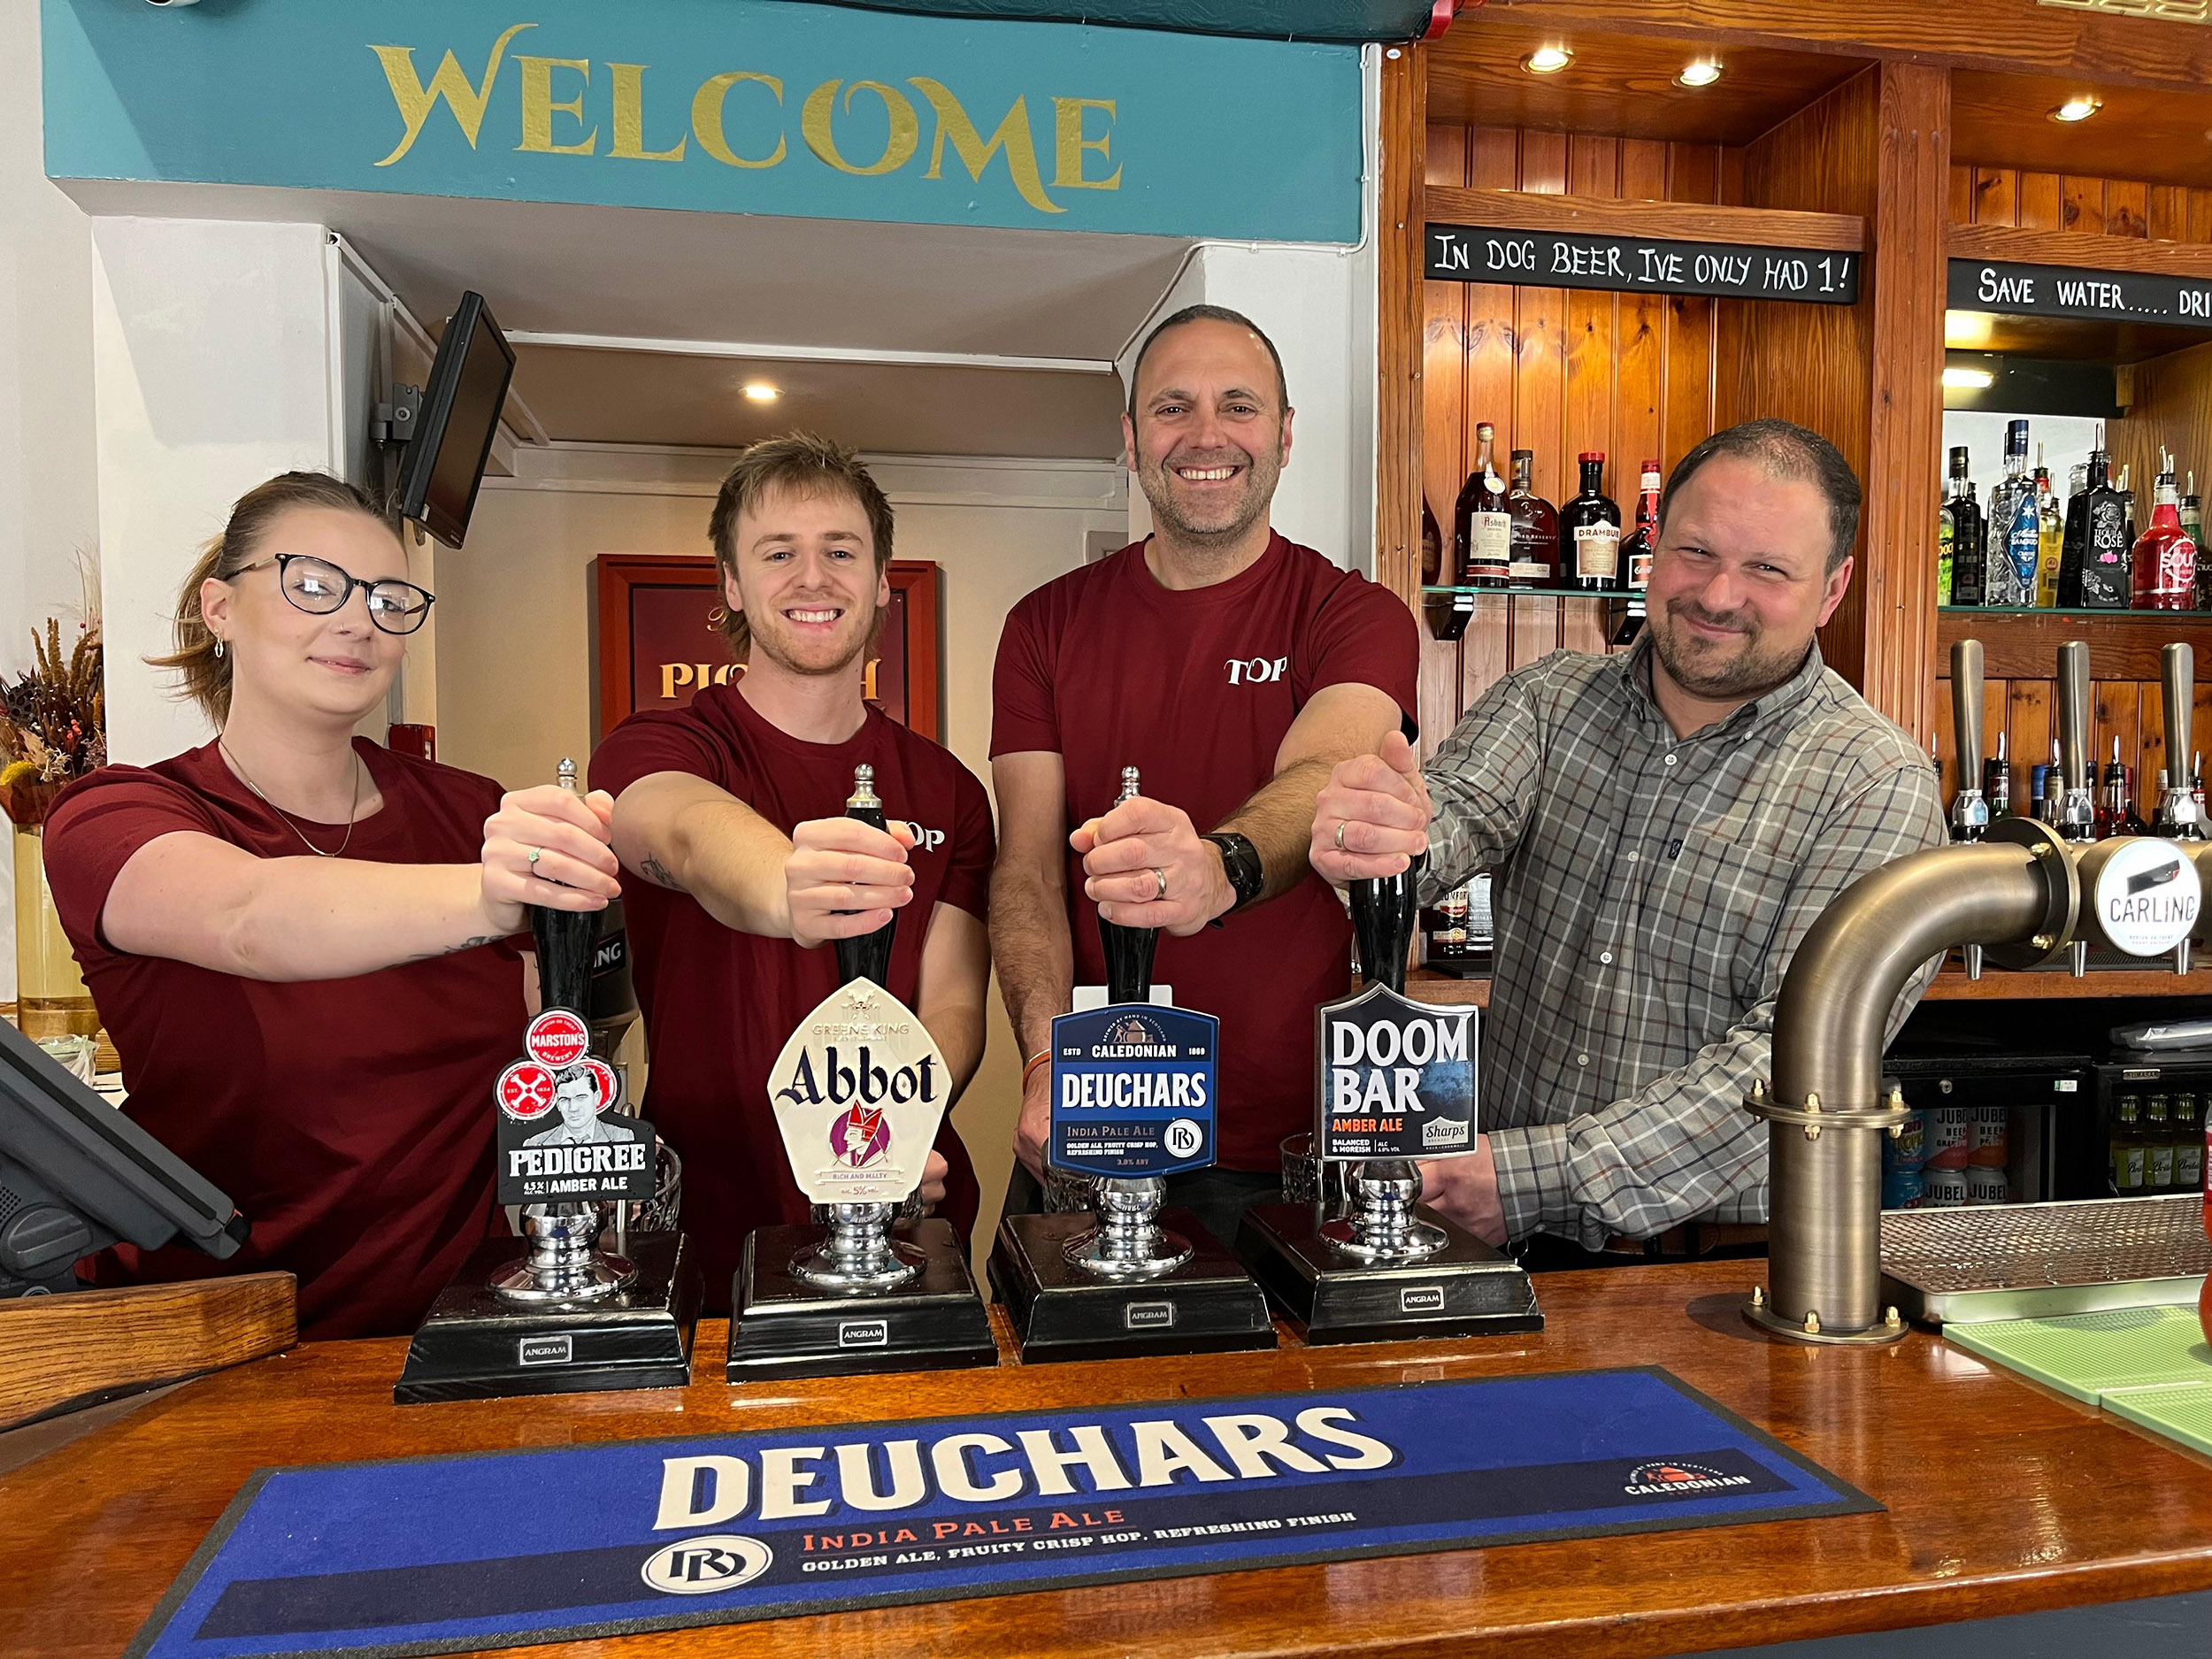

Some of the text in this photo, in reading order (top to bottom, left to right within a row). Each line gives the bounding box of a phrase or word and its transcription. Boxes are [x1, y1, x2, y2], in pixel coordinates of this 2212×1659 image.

[366, 23, 1125, 213] WELCOME
[1433, 234, 1851, 294] IN DOG BEER, IVE ONLY HAD 1!
[1978, 267, 2035, 304] SAVE
[2179, 289, 2212, 318] DRI
[2093, 528, 2124, 539] TEQUILA
[2093, 534, 2124, 549] ROSE
[1223, 656, 1287, 686] TOP
[906, 820, 946, 853] OP
[2109, 895, 2195, 923] CARLING
[812, 1022, 910, 1036] GREENE KING
[531, 1032, 585, 1048] MARSTON'S
[1332, 1017, 1470, 1067] DOOM
[541, 1050, 573, 1062] BREWERY
[1091, 1043, 1178, 1058] CALEDONIAN
[774, 1044, 938, 1106] Abbot
[1061, 1071, 1208, 1109] DEUCHARS
[1332, 1067, 1426, 1114] BAR
[1067, 1125, 1155, 1137] INDIA PALE ALE
[1332, 1118, 1403, 1133] AMBER ALE
[508, 1143, 647, 1178] PEDIGREE
[550, 1176, 628, 1194] AMBER ALE
[1925, 1184, 1965, 1201] JUBEL
[1970, 1184, 2007, 1201] JUBEL
[1405, 1293, 1440, 1305] ANGRAM
[1131, 1310, 1168, 1321] ANGRAM
[844, 1326, 883, 1340] ANGRAM
[525, 1345, 567, 1357] ANGRAM
[651, 1407, 1394, 1531] DEUCHARS
[1624, 1475, 1752, 1495] CALEDONIAN
[803, 1509, 1125, 1552] INDIA PALE ALE
[802, 1555, 888, 1572] GOLDEN
[948, 1540, 1026, 1560] FRUITY
[1033, 1536, 1094, 1550] CRISP
[1153, 1518, 1282, 1540] REFRESHING
[1286, 1511, 1357, 1528] FINISH
